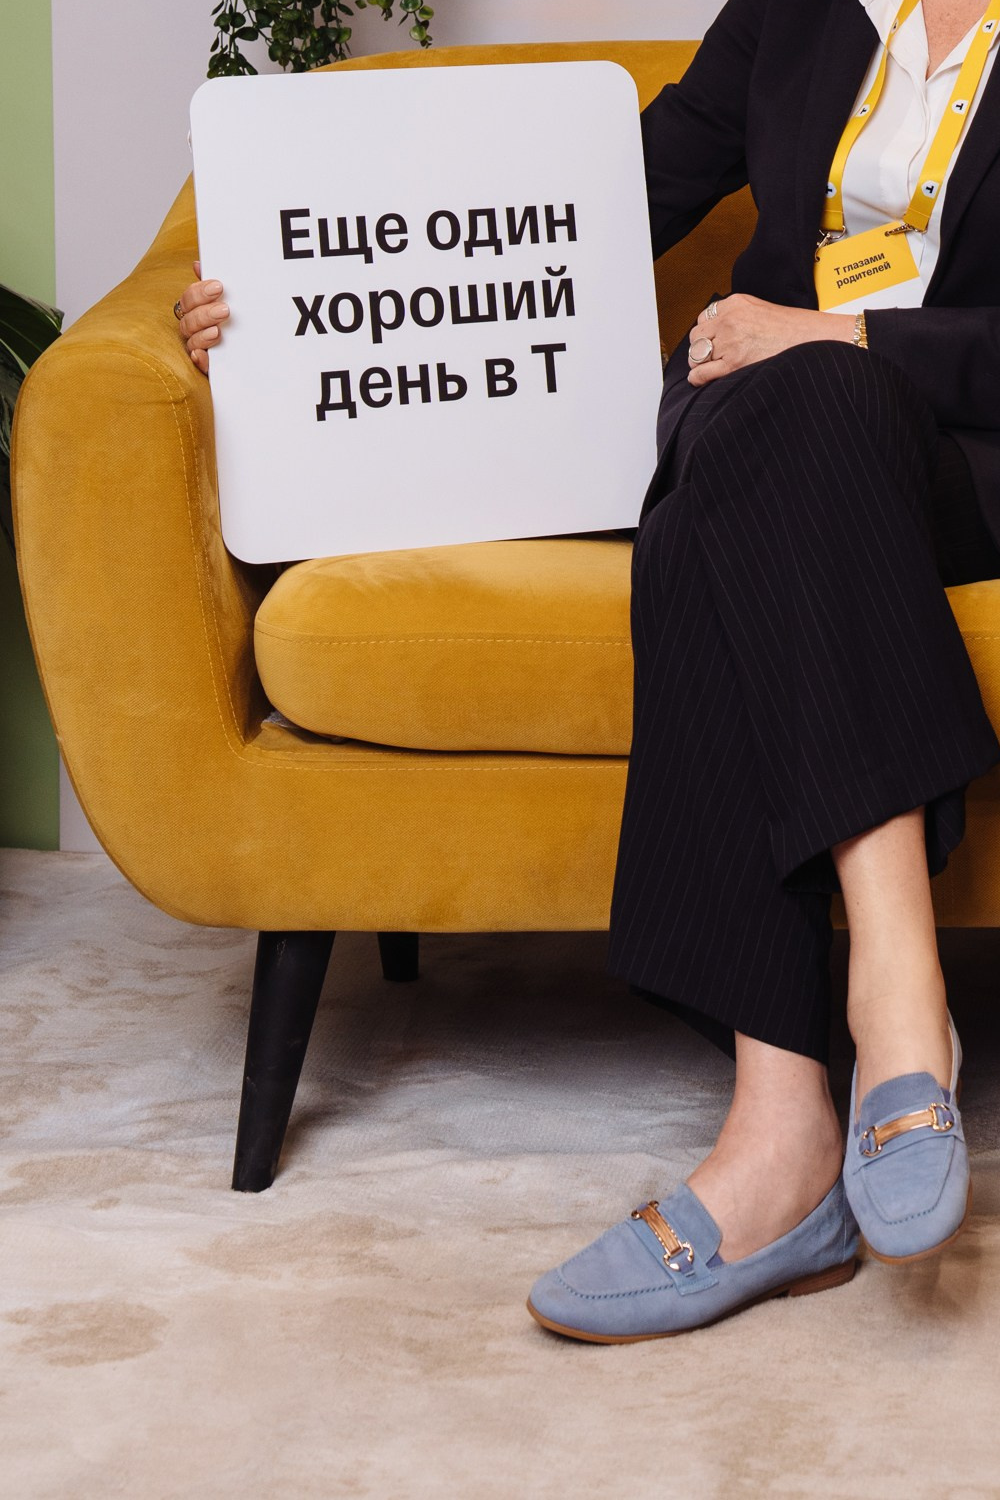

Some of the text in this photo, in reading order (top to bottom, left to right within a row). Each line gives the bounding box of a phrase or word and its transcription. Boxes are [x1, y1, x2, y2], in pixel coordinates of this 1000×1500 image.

[279, 203, 578, 265] Еще один
[834, 252, 886, 276] Т глазами
[291, 265, 576, 344] хороший
[836, 261, 892, 288] родителей
[315, 342, 567, 422] день в Т
